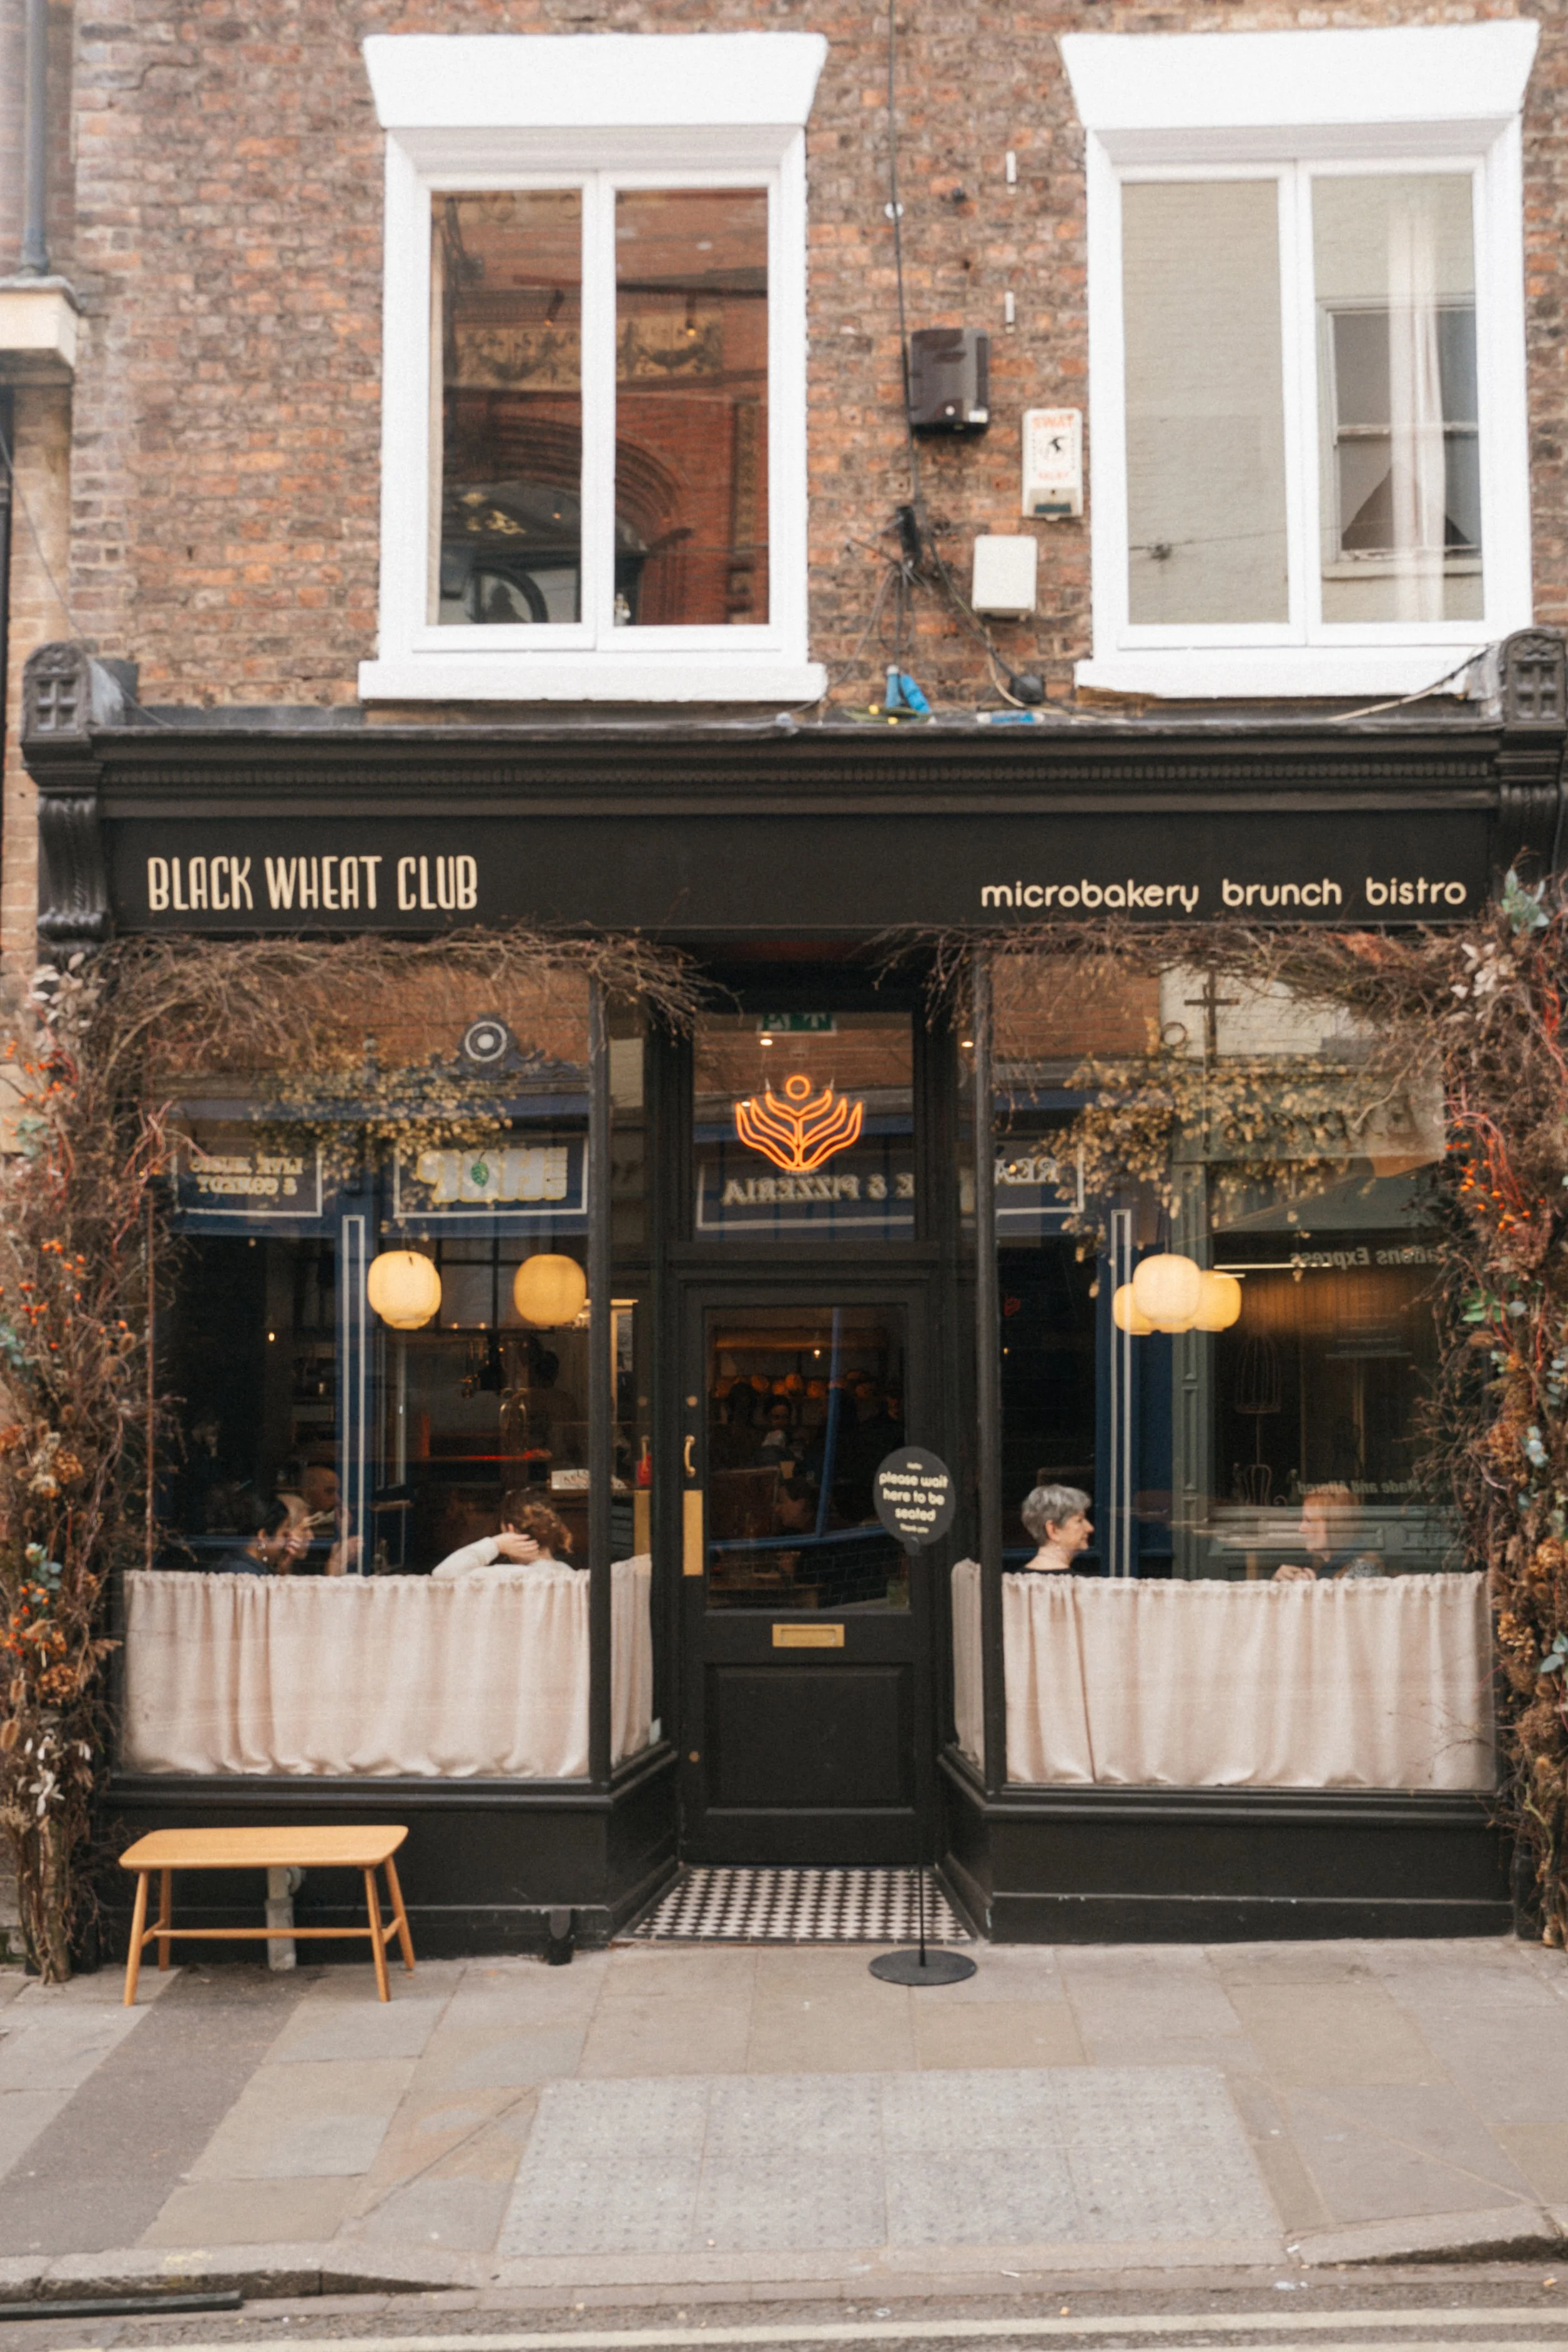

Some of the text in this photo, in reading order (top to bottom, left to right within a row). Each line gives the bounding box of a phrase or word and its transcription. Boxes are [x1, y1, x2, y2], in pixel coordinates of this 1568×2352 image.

[147, 855, 477, 911] BLACK WHEAT CLUB
[981, 877, 1466, 913] microbakery brunch bistro
[879, 1471, 948, 1488] please wait
[882, 1487, 945, 1506] here to be
[894, 1507, 936, 1522] seated
